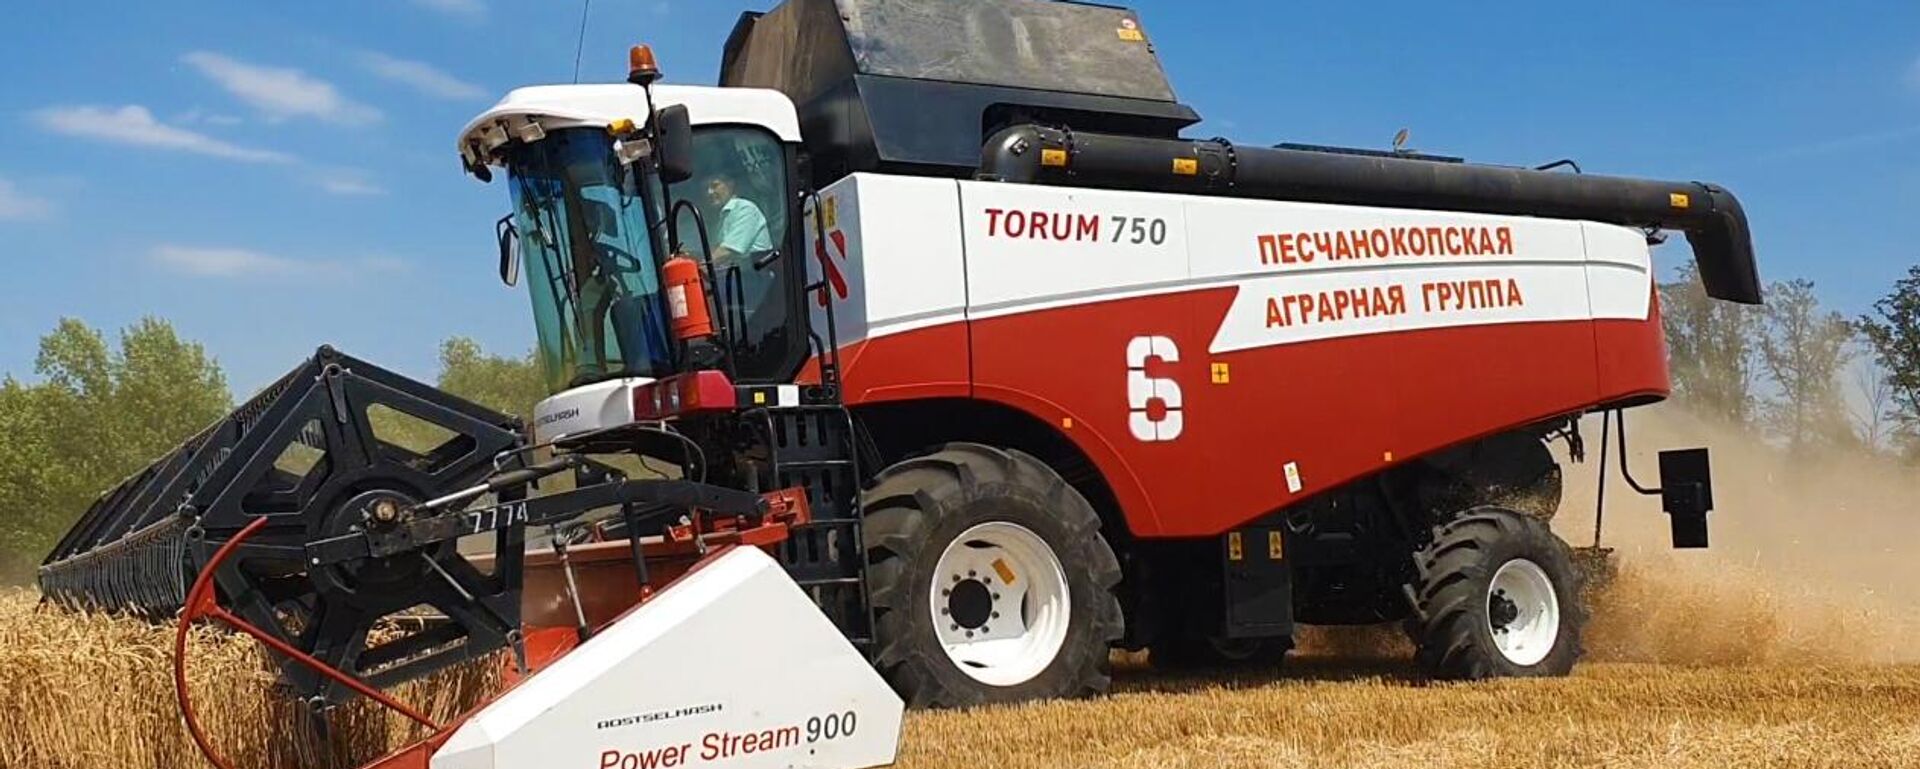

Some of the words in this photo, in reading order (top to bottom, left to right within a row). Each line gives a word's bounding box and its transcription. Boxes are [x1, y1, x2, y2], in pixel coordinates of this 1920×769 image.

[985, 208, 1100, 242] TORUM
[1111, 216, 1167, 245] 750
[1257, 226, 1514, 265] ПЕСЧАНОКОПСКАЯ
[1265, 284, 1406, 328] АГРАРНАЯ
[1421, 278, 1524, 312] ГРУППА
[1126, 335, 1184, 441] 6
[468, 501, 529, 534] 7774
[600, 743, 692, 769] Power
[700, 726, 800, 761] Stream
[806, 710, 857, 743] 900
